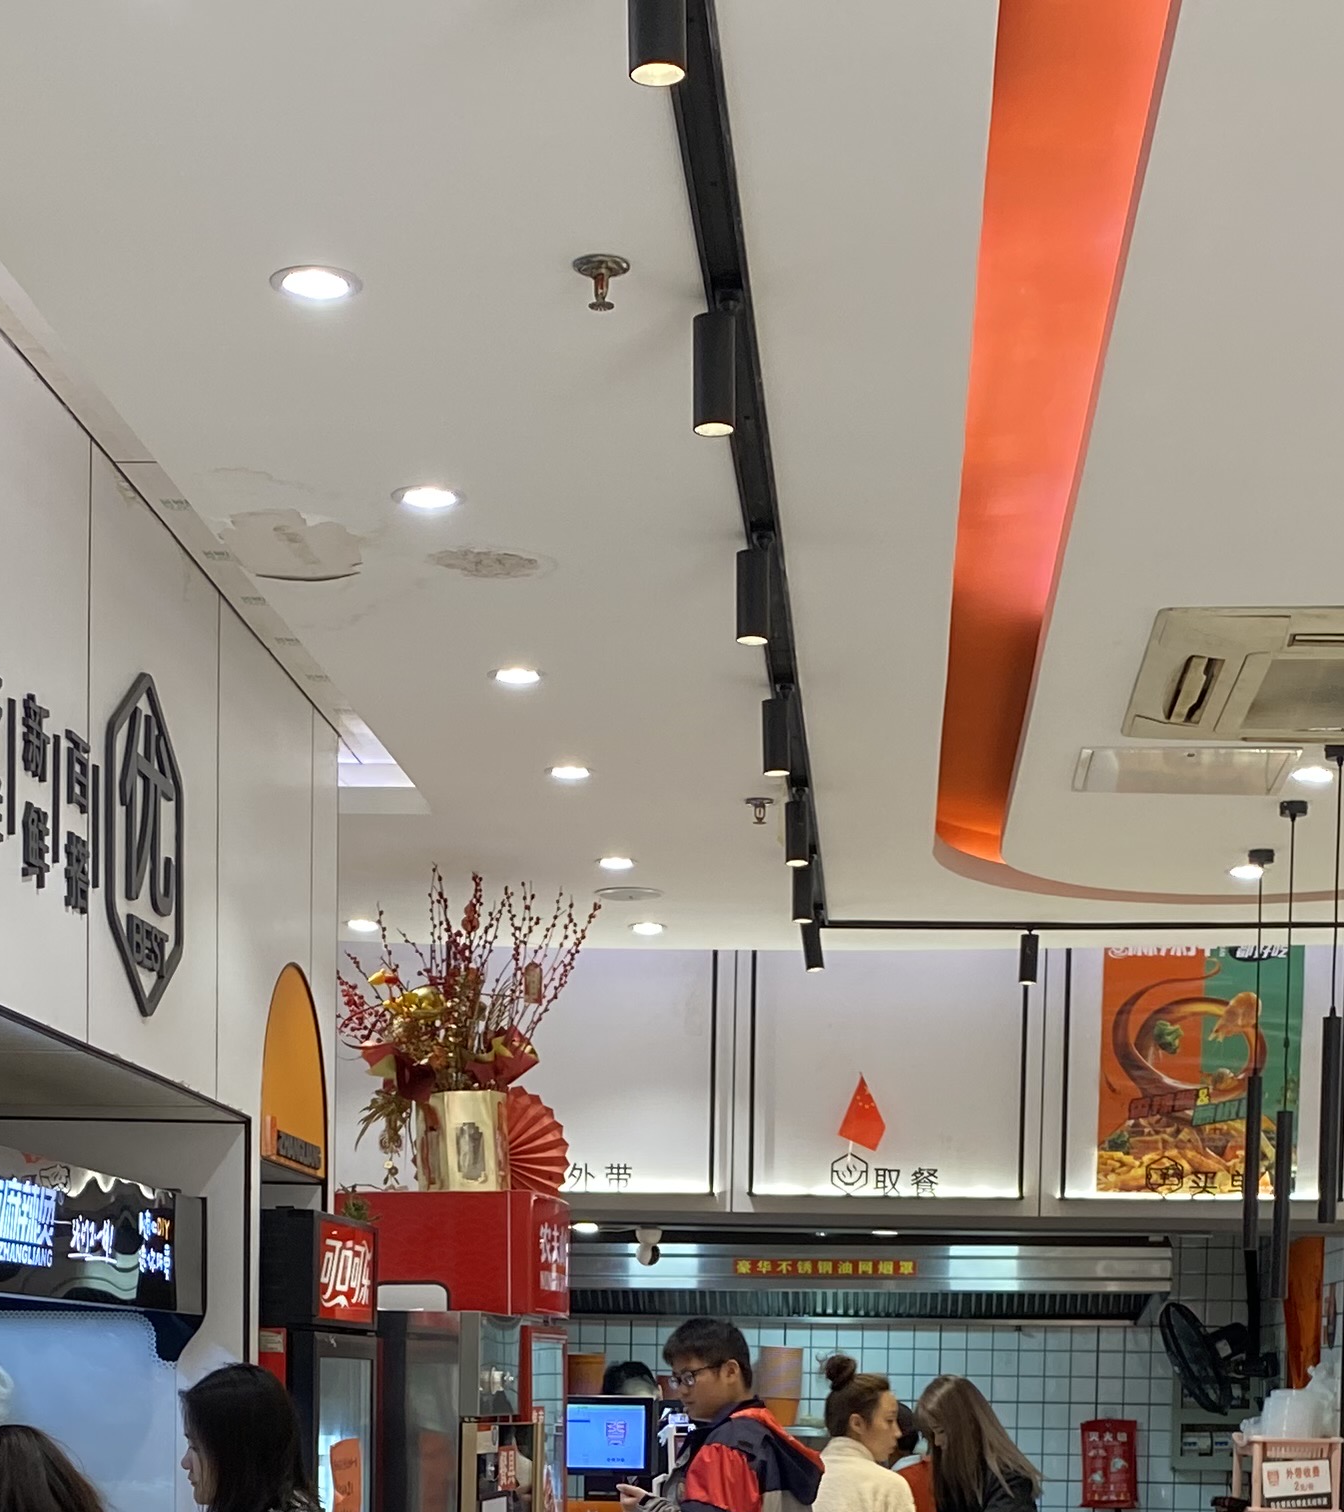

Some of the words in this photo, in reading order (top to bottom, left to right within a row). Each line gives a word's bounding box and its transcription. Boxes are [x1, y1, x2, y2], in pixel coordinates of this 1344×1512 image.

[22, 693, 50, 889] 新鲜
[65, 729, 90, 914] 百搭
[119, 706, 174, 917] 优
[127, 913, 169, 979] BEST
[567, 1162, 633, 1193] 外带
[873, 1167, 939, 1198] 取餐
